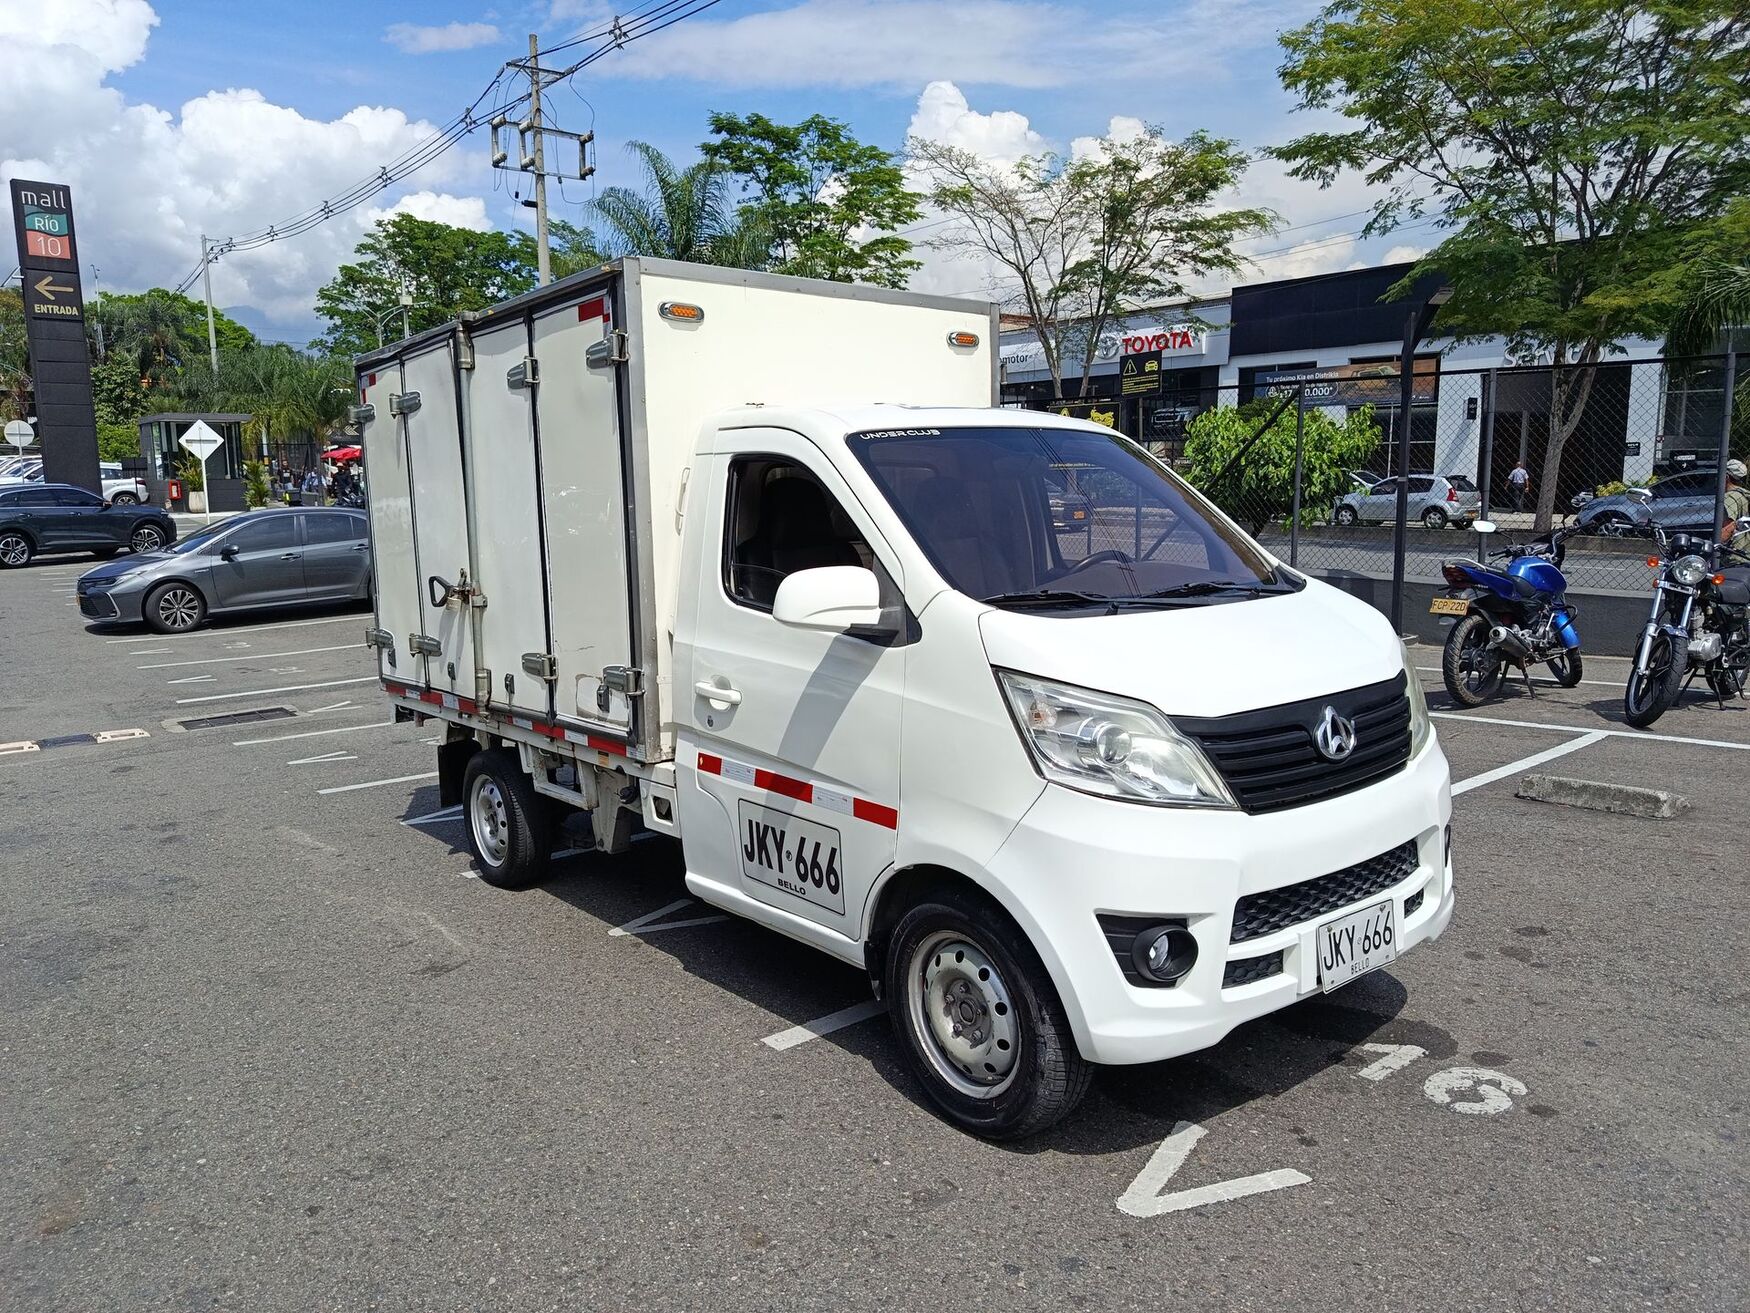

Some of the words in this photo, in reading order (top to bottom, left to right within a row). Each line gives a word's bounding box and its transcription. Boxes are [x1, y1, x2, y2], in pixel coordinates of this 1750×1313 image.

[21, 190, 66, 209] mall
[34, 214, 59, 232] RÍO
[37, 237, 61, 257] 10
[34, 304, 79, 316] ENTRADA
[1122, 331, 1193, 354] TOYOTA
[860, 431, 907, 440] UNDER
[1433, 600, 1448, 610] FCP
[1450, 601, 1466, 611] 22D
[744, 819, 785, 873] JKY
[795, 836, 840, 895] 666
[777, 878, 806, 895] BELLO
[1323, 925, 1355, 971] JKY
[1362, 910, 1393, 955] 666
[1350, 957, 1370, 975] BELLO
